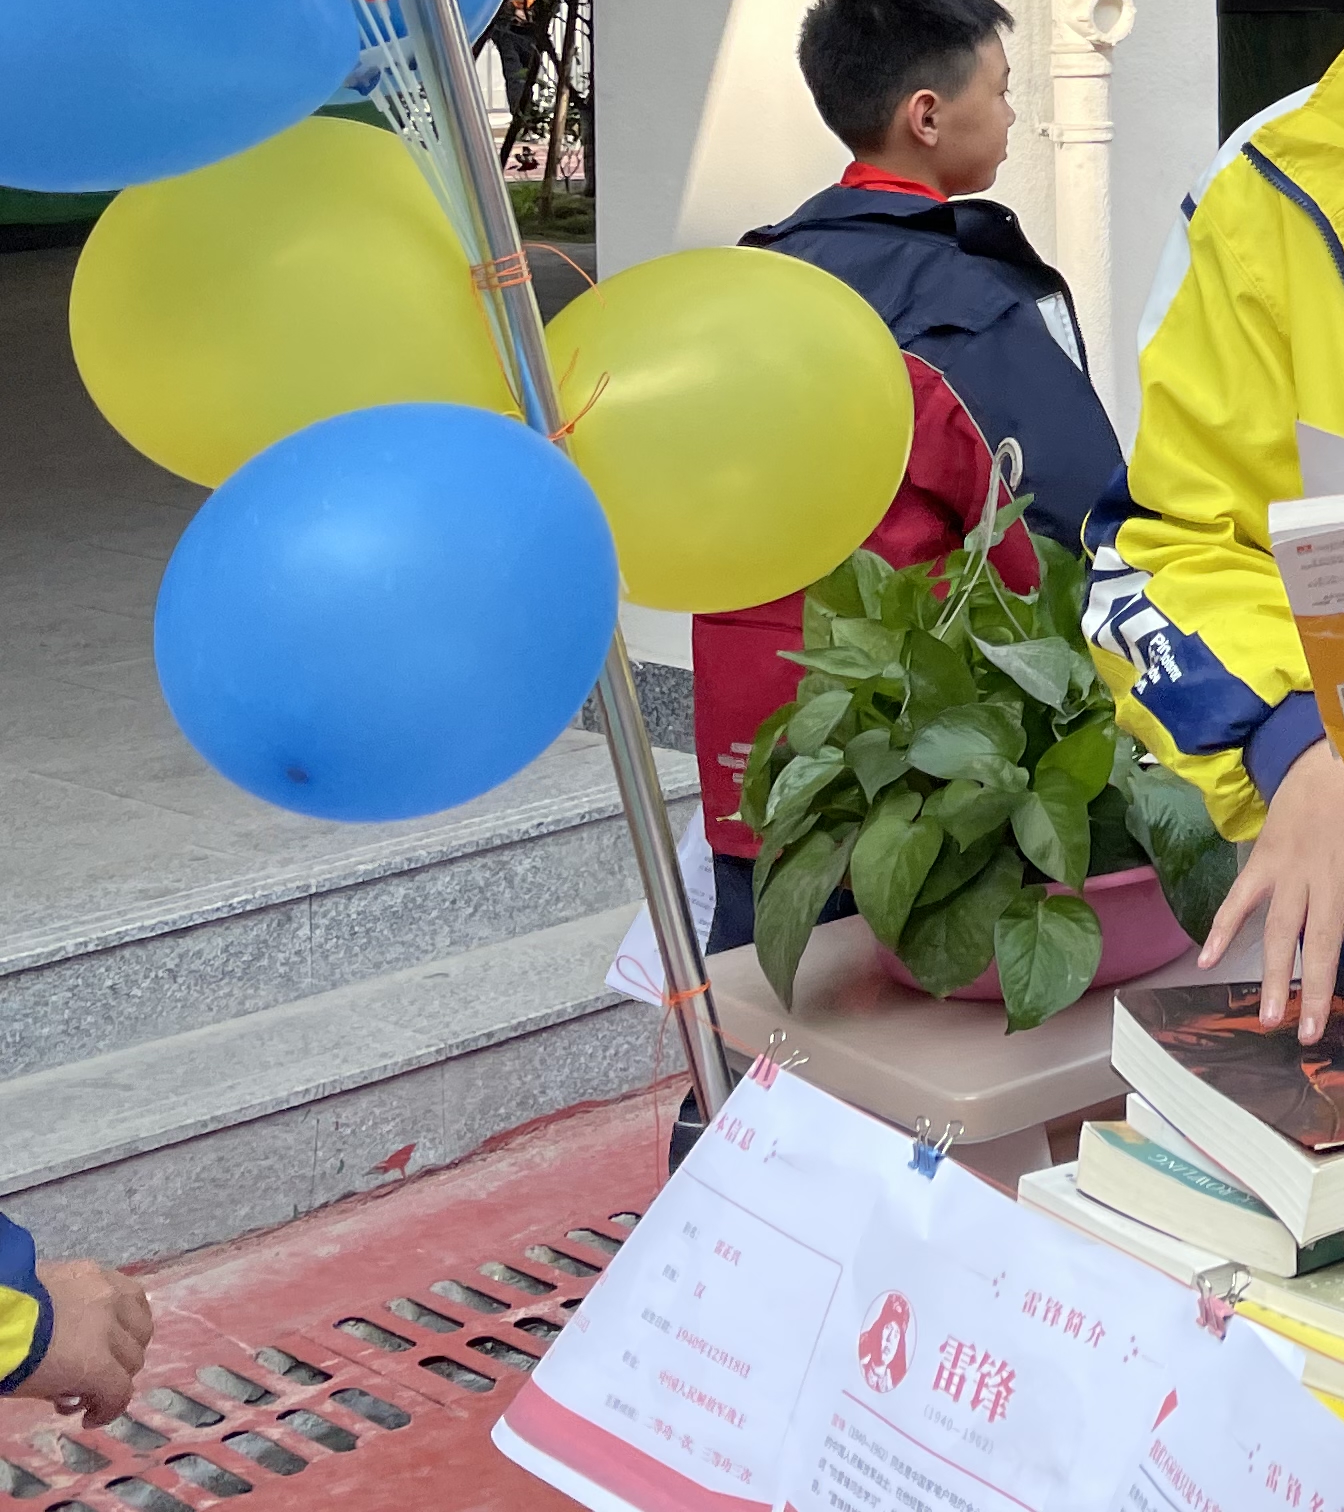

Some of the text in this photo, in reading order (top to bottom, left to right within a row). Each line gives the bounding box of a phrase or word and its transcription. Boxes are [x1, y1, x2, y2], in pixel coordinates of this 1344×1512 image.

[1022, 1289, 1106, 1348] 雷锋简介
[932, 1334, 1016, 1423] 雷锋
